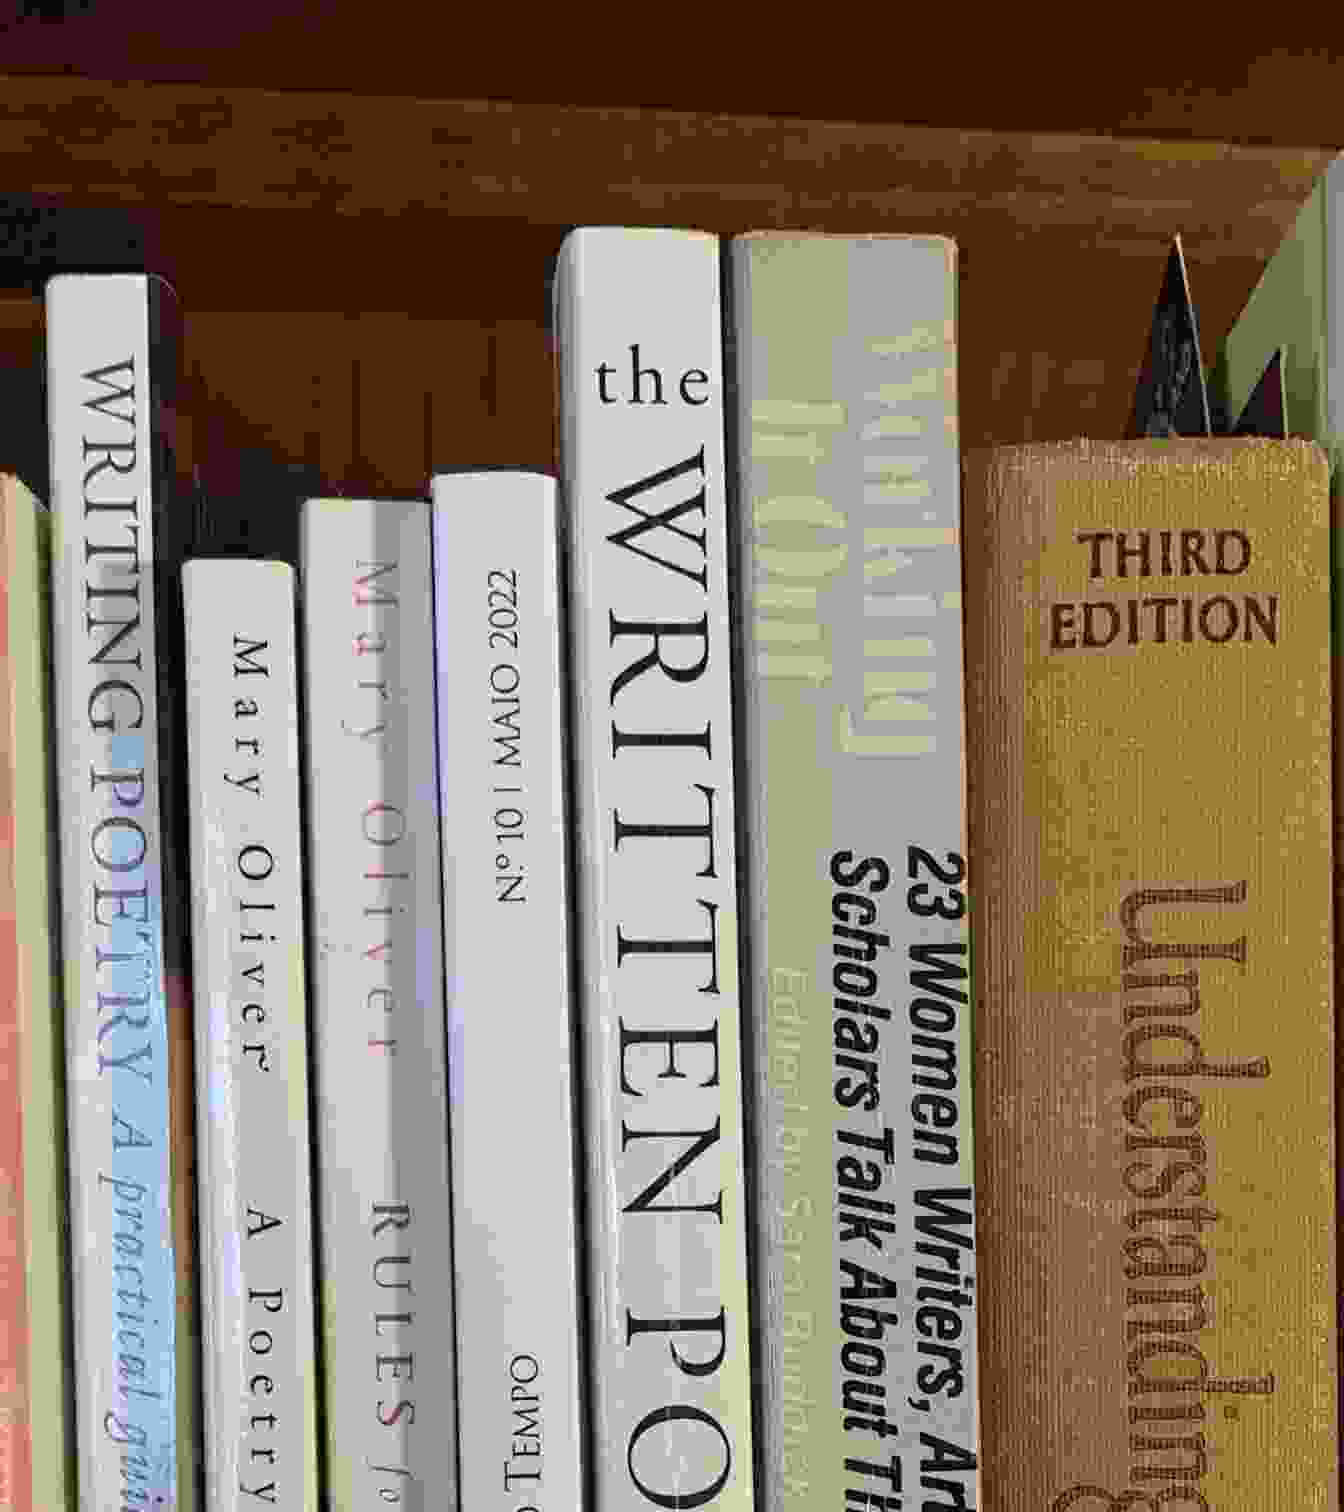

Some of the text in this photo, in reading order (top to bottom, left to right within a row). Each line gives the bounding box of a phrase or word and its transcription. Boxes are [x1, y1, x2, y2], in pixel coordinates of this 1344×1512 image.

[594, 344, 710, 405] the
[80, 358, 143, 733] WRITING
[1051, 597, 1278, 648] EDITION
[1077, 529, 1251, 577] THIRD
[487, 568, 521, 767] MAIO 2022
[224, 634, 278, 1075] Mary Oliver
[341, 560, 410, 1058] Mary Oliver
[604, 445, 724, 1224] WRITTEN
[906, 846, 968, 920] 23
[88, 764, 154, 1084] POETRY
[829, 850, 892, 1112] Scholars
[111, 1108, 152, 1149] A
[908, 943, 968, 1165] Women
[99, 1172, 162, 1402] practical
[246, 1207, 282, 1240] A
[836, 1128, 896, 1250] Talk
[240, 1288, 284, 1504] Poetry
[372, 1200, 415, 1426] RULES
[839, 1258, 898, 1437] About
[908, 1187, 974, 1412] Writers,
[504, 1353, 544, 1494] TEMPO
